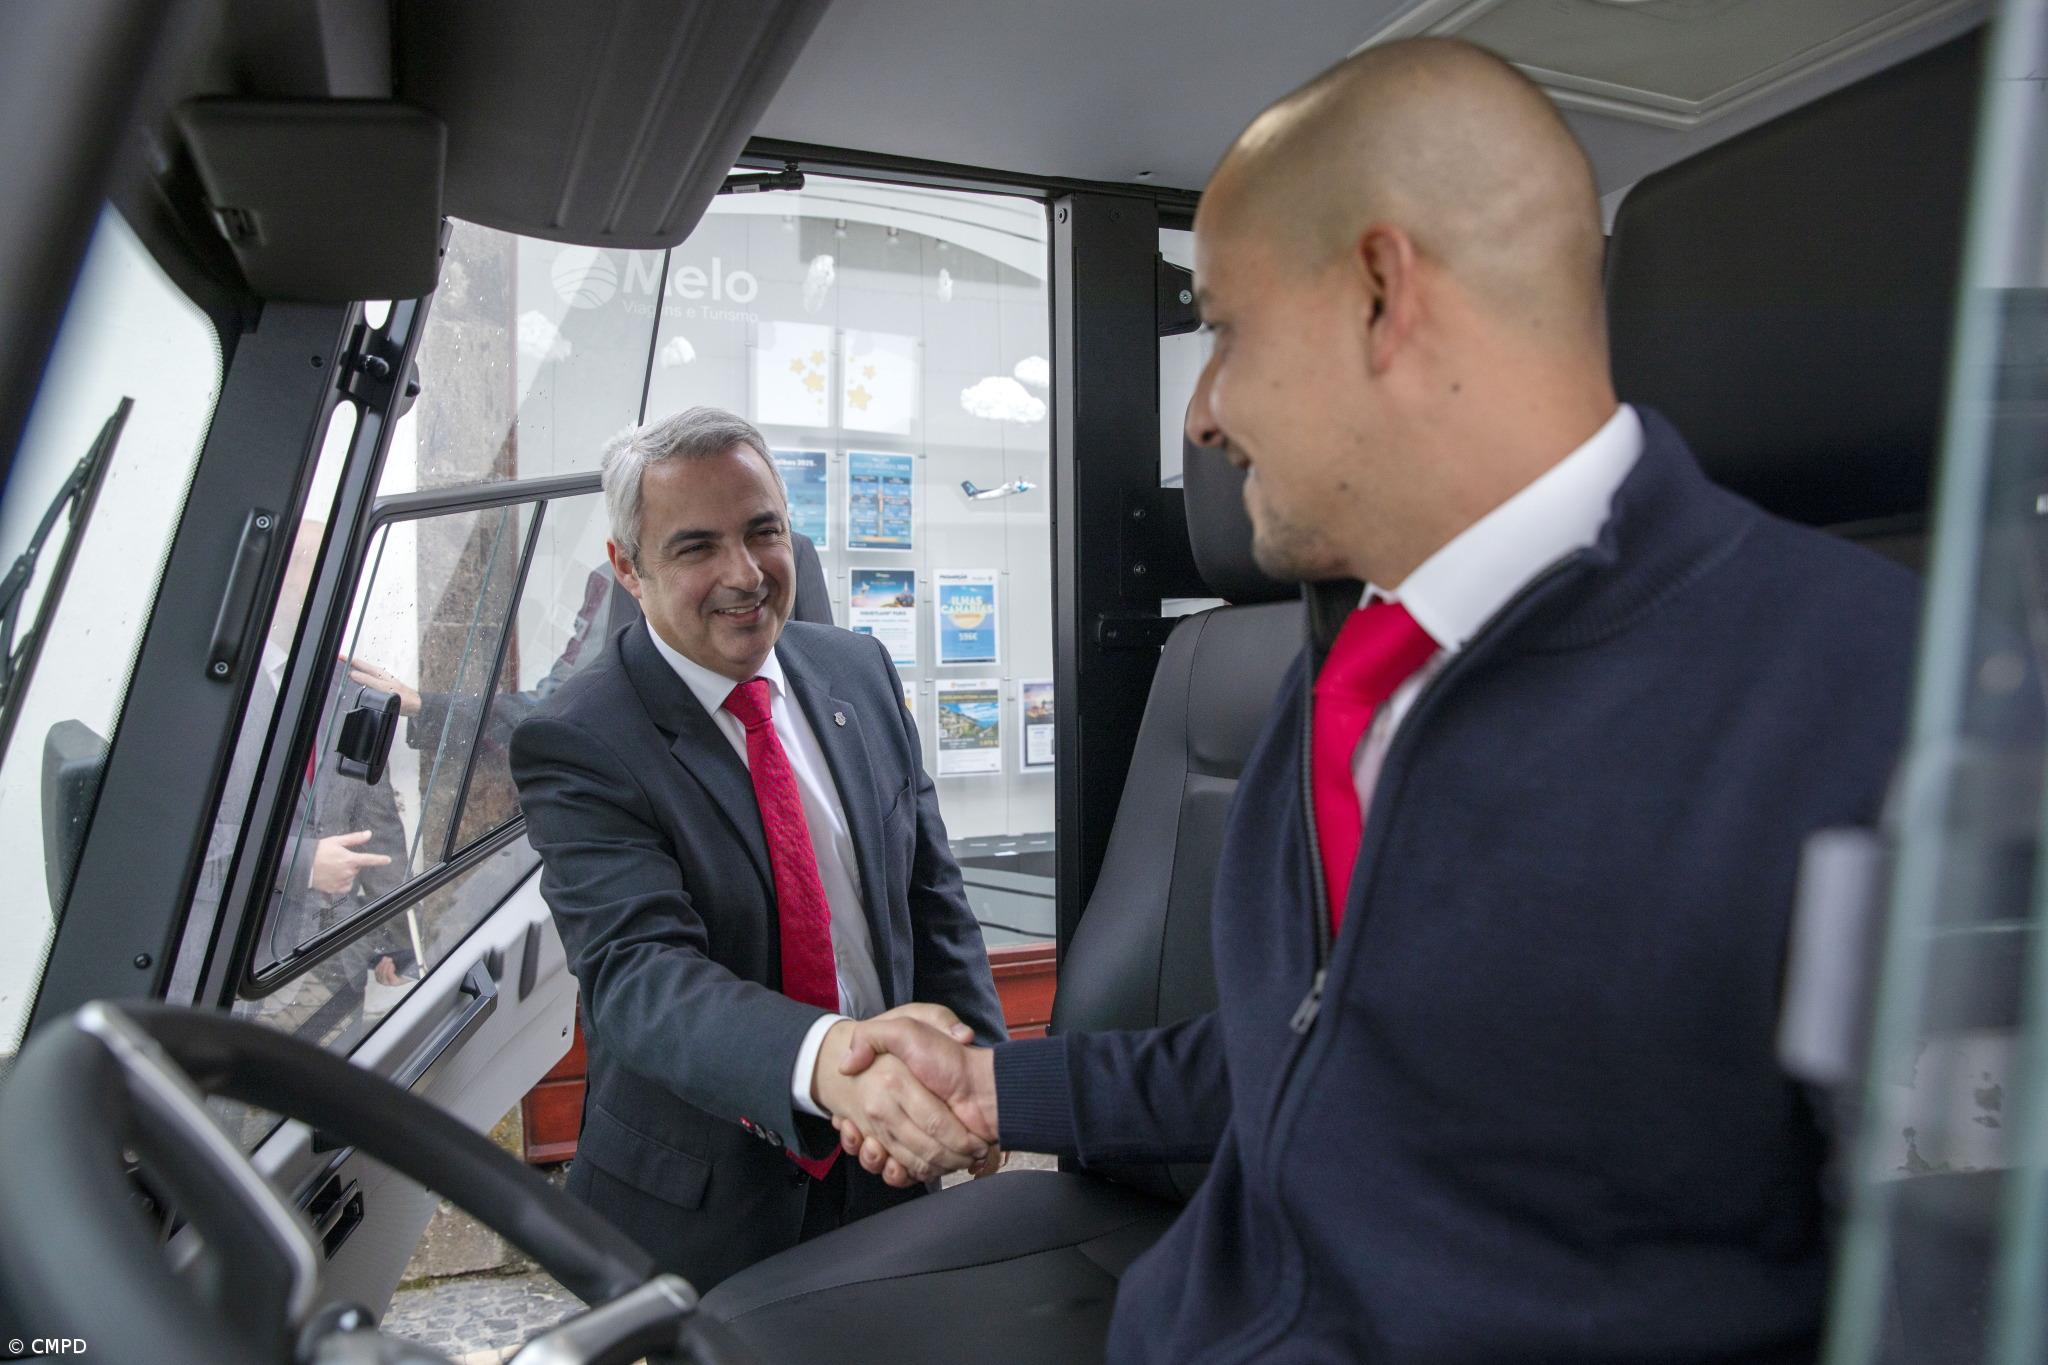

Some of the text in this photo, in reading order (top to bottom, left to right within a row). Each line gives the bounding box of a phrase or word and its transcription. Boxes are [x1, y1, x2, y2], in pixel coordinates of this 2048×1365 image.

[622, 250, 758, 303] Melo
[622, 300, 758, 322] Viagns e Turismo
